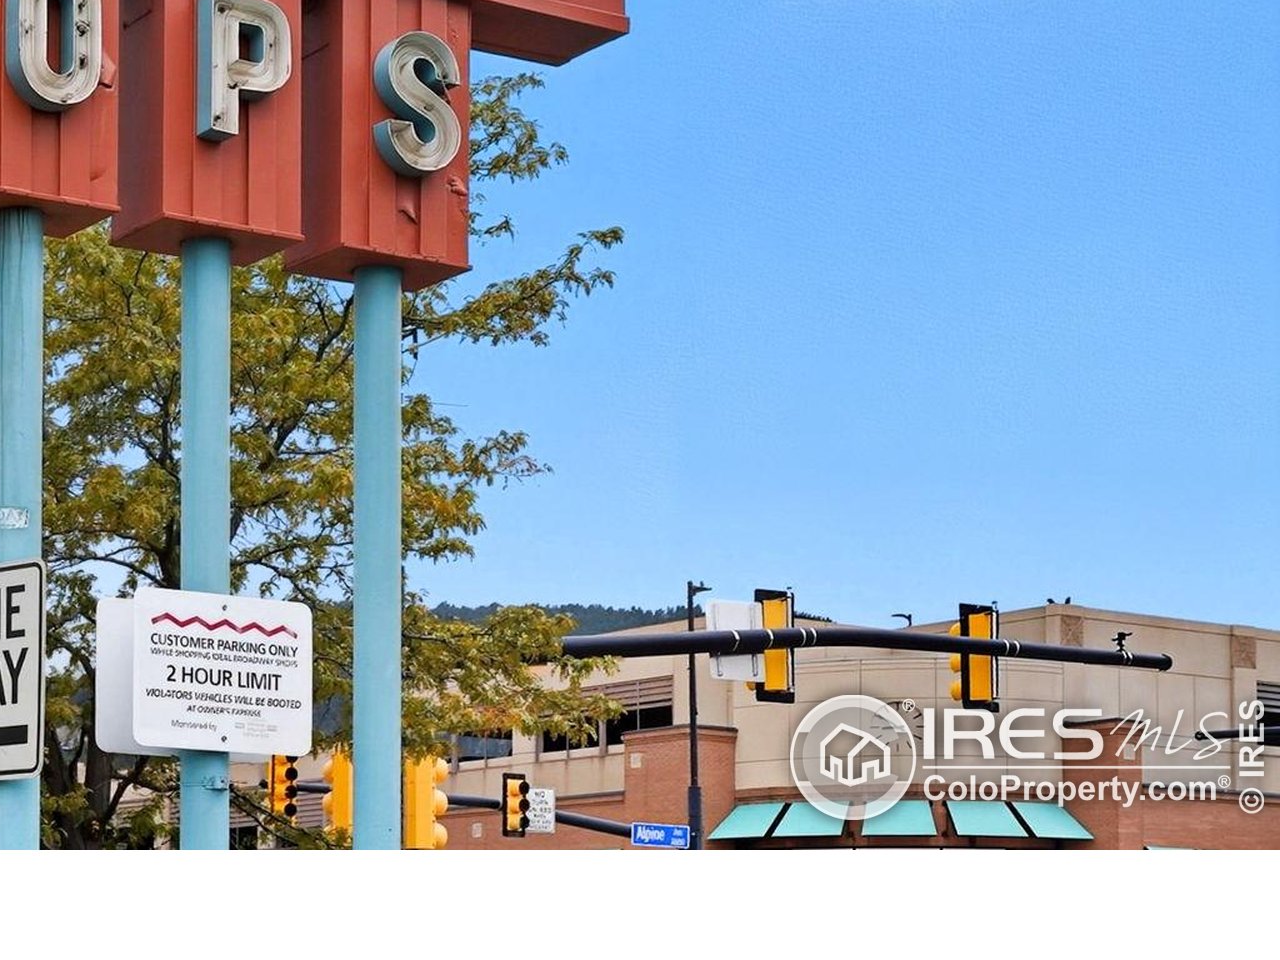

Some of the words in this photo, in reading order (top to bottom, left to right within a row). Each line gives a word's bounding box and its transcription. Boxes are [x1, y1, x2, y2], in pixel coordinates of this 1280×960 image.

[150, 632, 215, 650] CUSTOMER
[217, 639, 266, 655] PARKING
[268, 644, 299, 658] ONLY
[166, 664, 177, 683] 2
[181, 666, 233, 687] HOUR
[238, 671, 282, 691] LIMIT
[145, 688, 193, 701] VIOLATORS
[194, 692, 233, 704] VEHICLES
[234, 695, 254, 706] WILL
[255, 698, 265, 707] BE
[267, 699, 302, 710] BOOTED
[635, 825, 665, 843] Alpine
